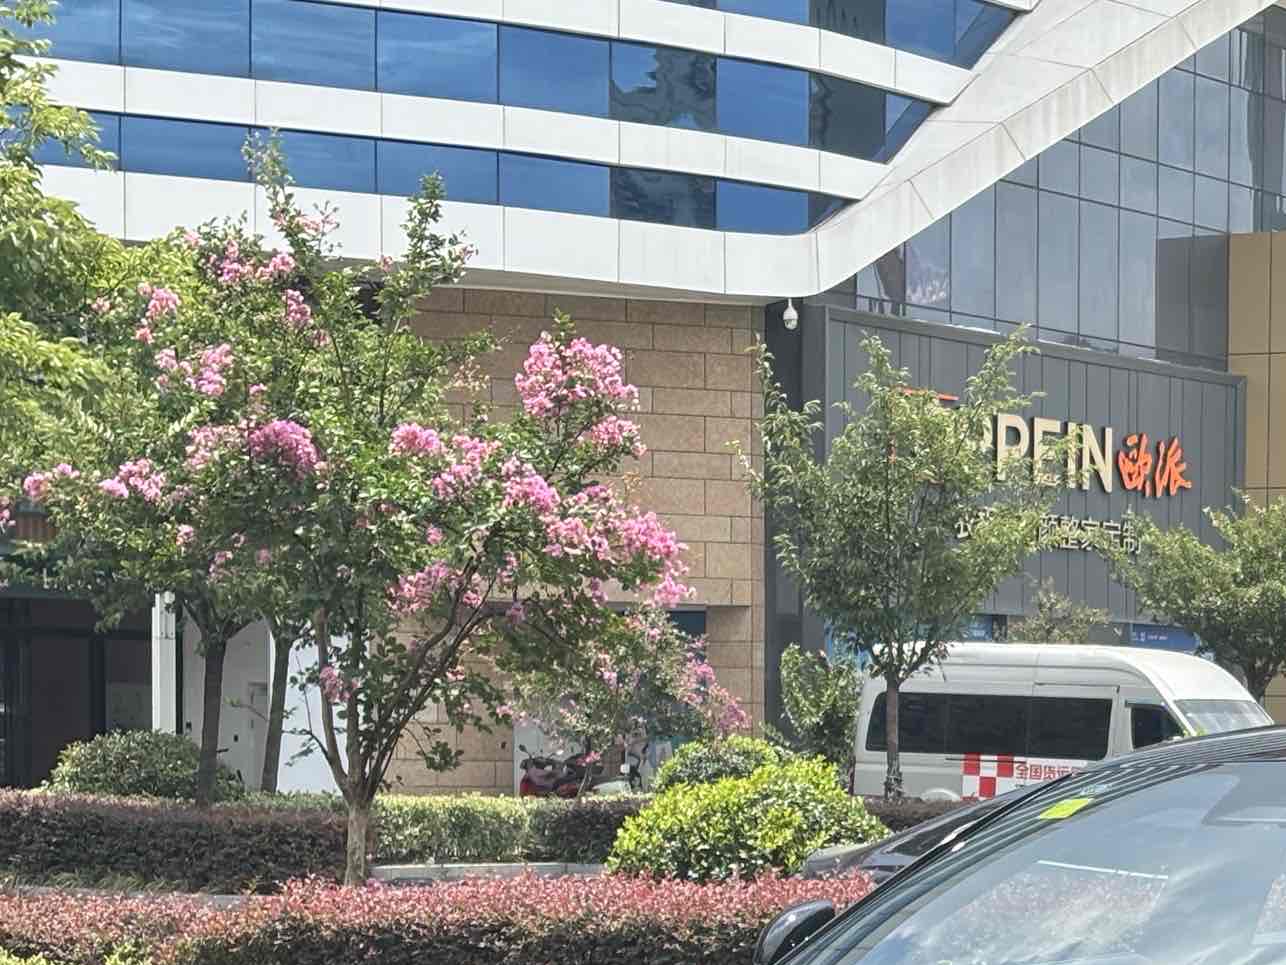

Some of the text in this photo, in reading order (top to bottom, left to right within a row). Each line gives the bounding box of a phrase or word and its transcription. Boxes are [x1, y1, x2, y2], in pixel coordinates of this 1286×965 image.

[982, 412, 1113, 494] PEIN
[1015, 763, 1080, 780] 全国货运
